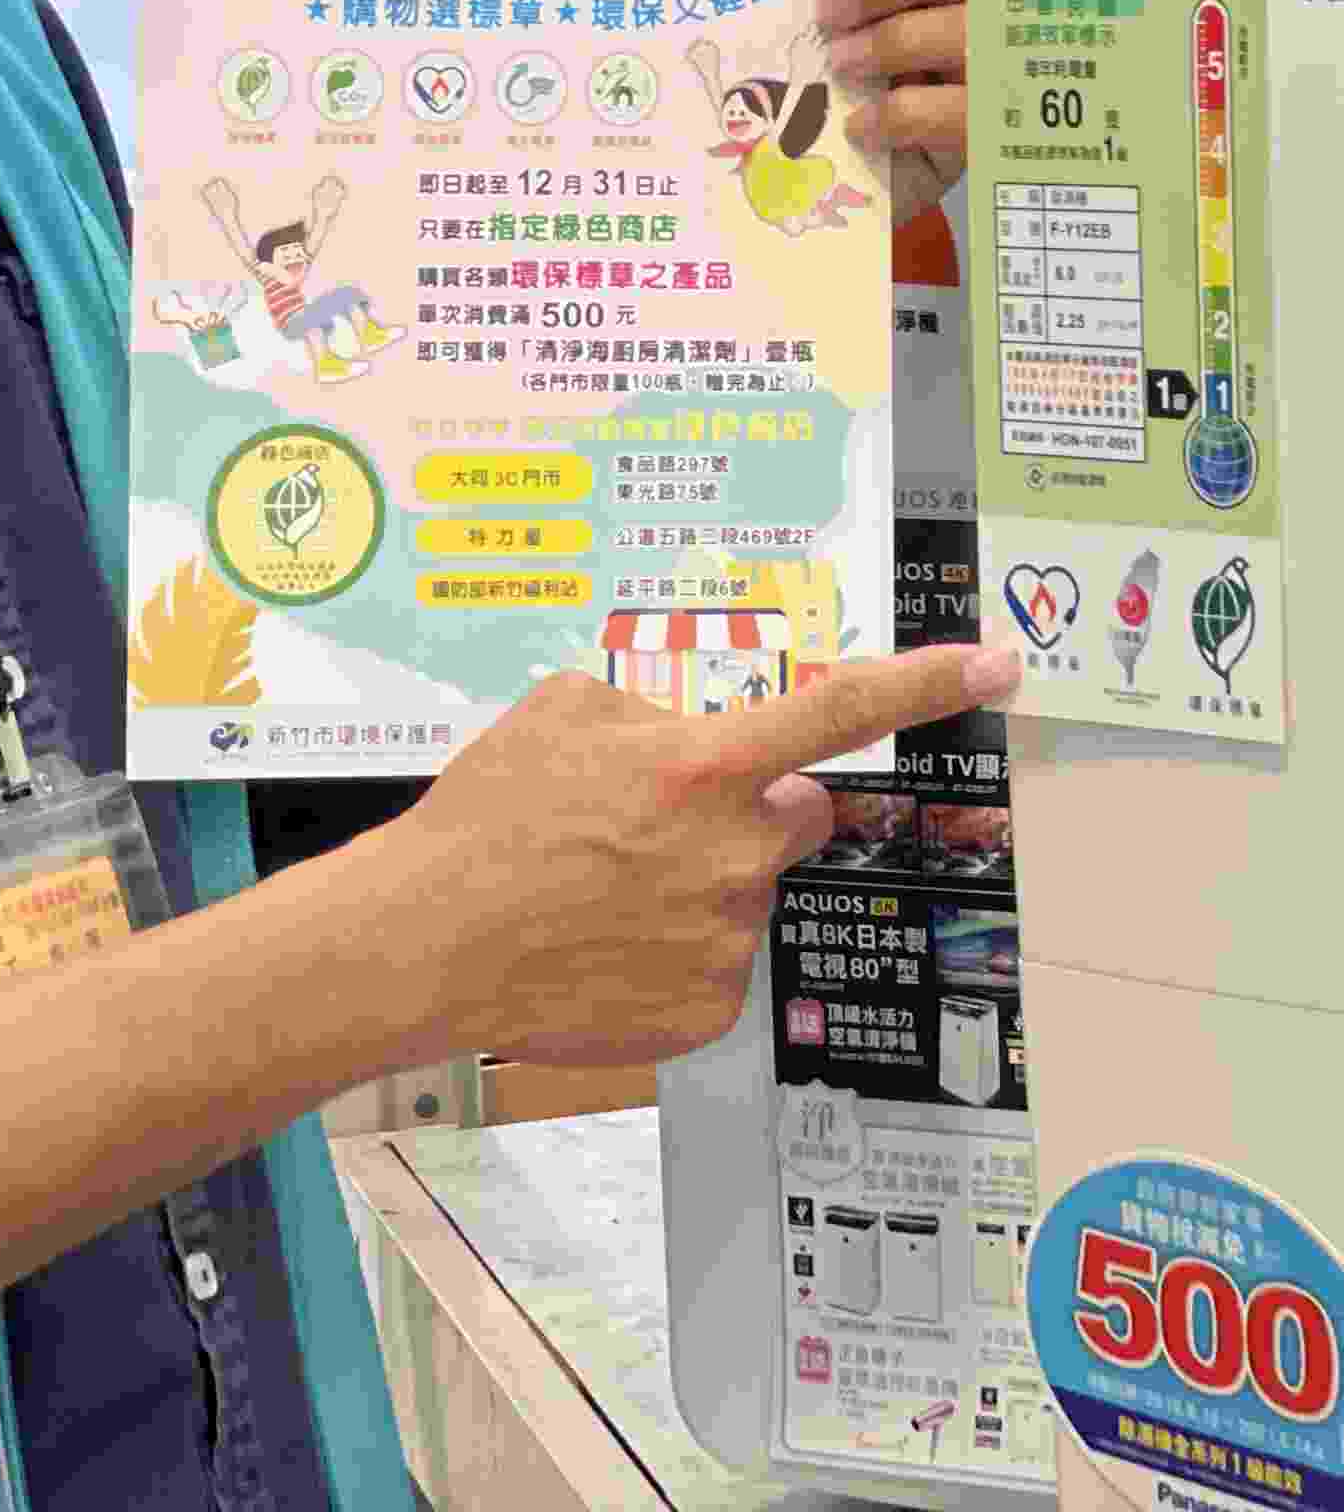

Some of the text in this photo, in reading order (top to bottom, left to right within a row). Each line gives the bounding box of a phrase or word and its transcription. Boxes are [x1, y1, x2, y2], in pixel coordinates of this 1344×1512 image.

[1207, 51, 1224, 81] 5
[1040, 88, 1083, 128] 60
[417, 169, 680, 197] 即日起至 12 月 31 日止
[542, 300, 604, 329] 500
[615, 305, 637, 327] 元
[784, 893, 865, 916] AQUOS
[1073, 1227, 1340, 1423] 500
